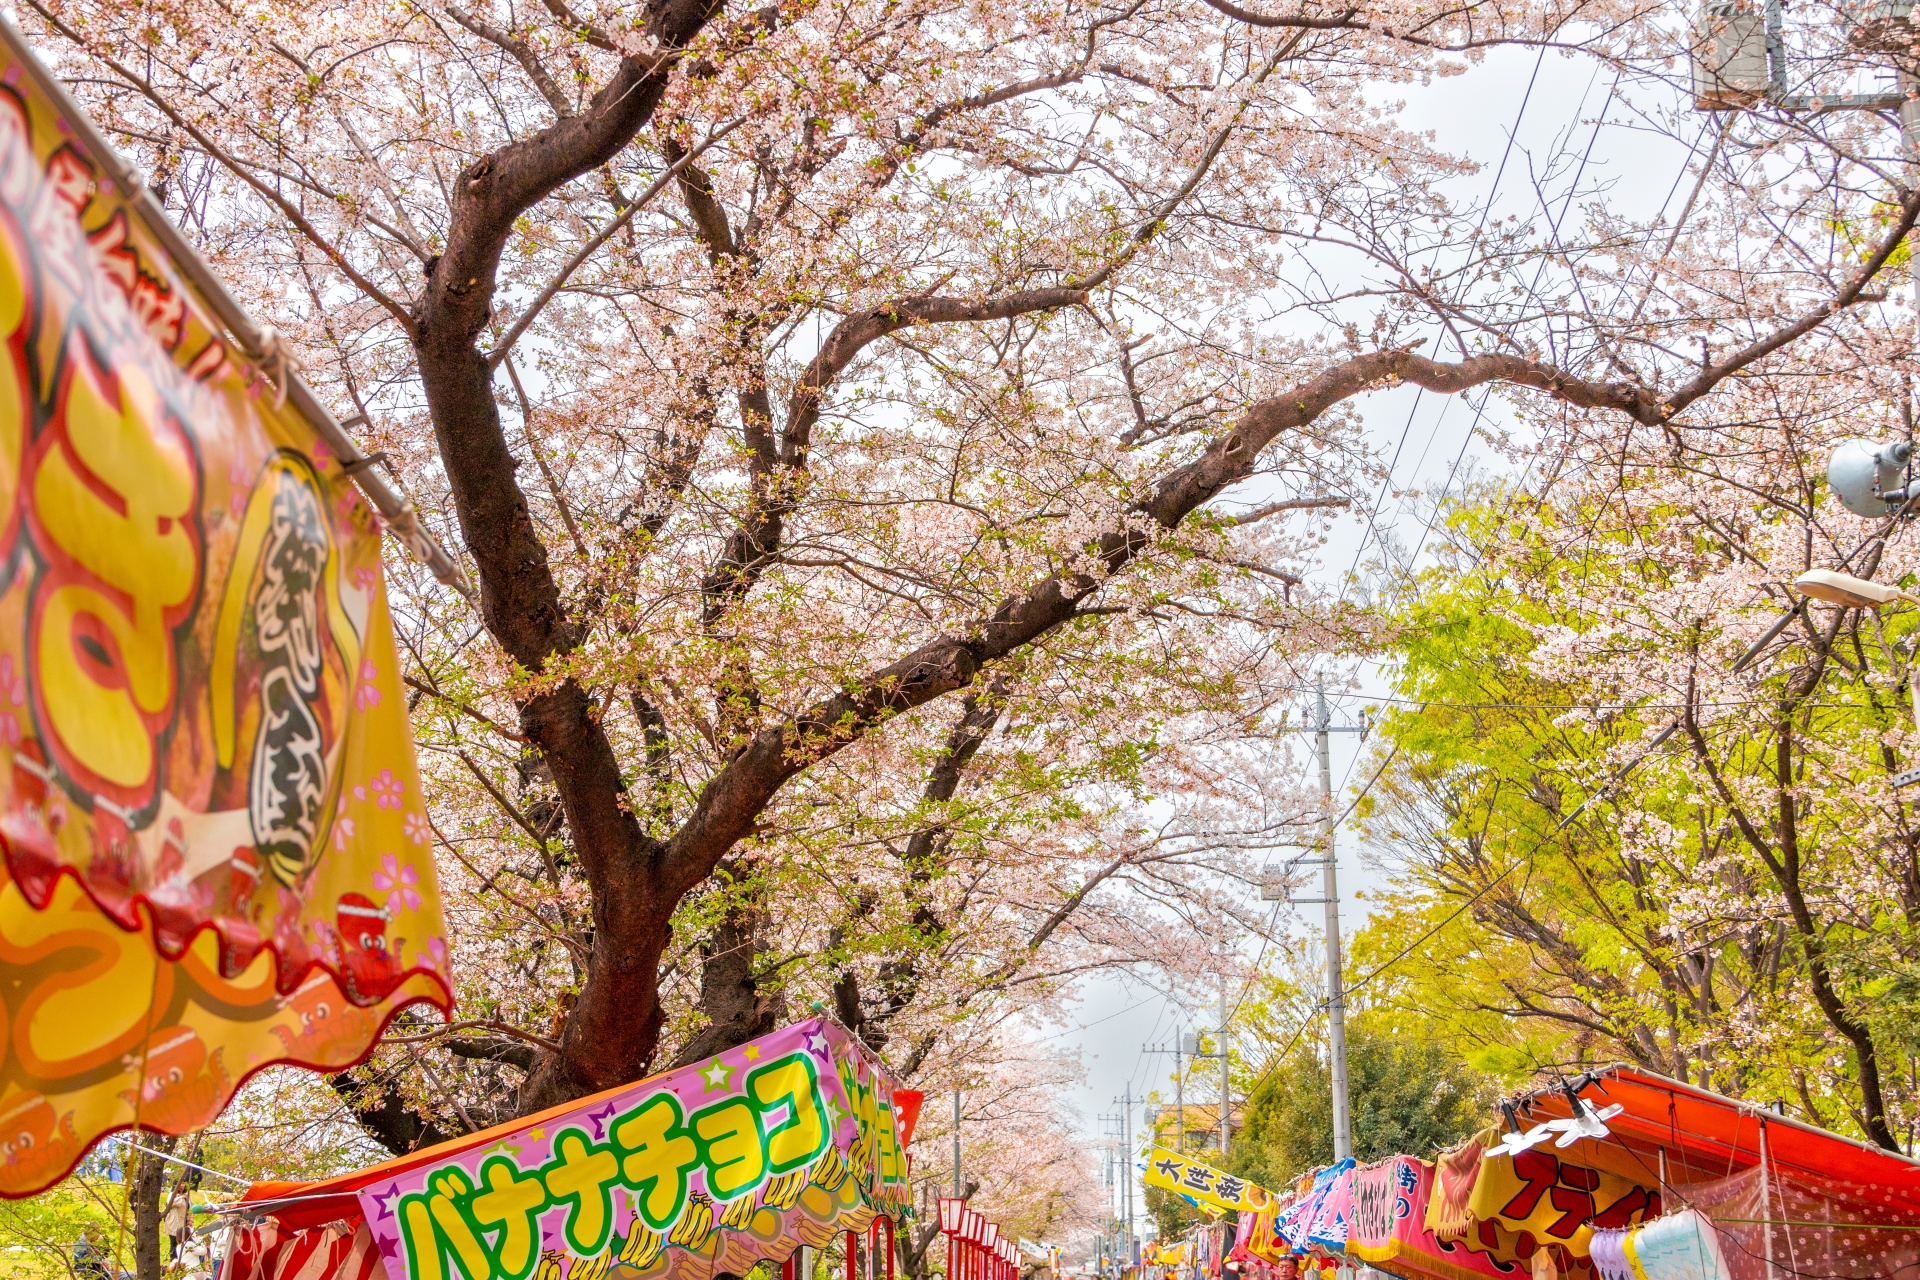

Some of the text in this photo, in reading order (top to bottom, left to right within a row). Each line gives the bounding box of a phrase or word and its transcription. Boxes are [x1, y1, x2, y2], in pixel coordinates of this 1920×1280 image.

[396, 1048, 836, 1280] バナナチョコ
